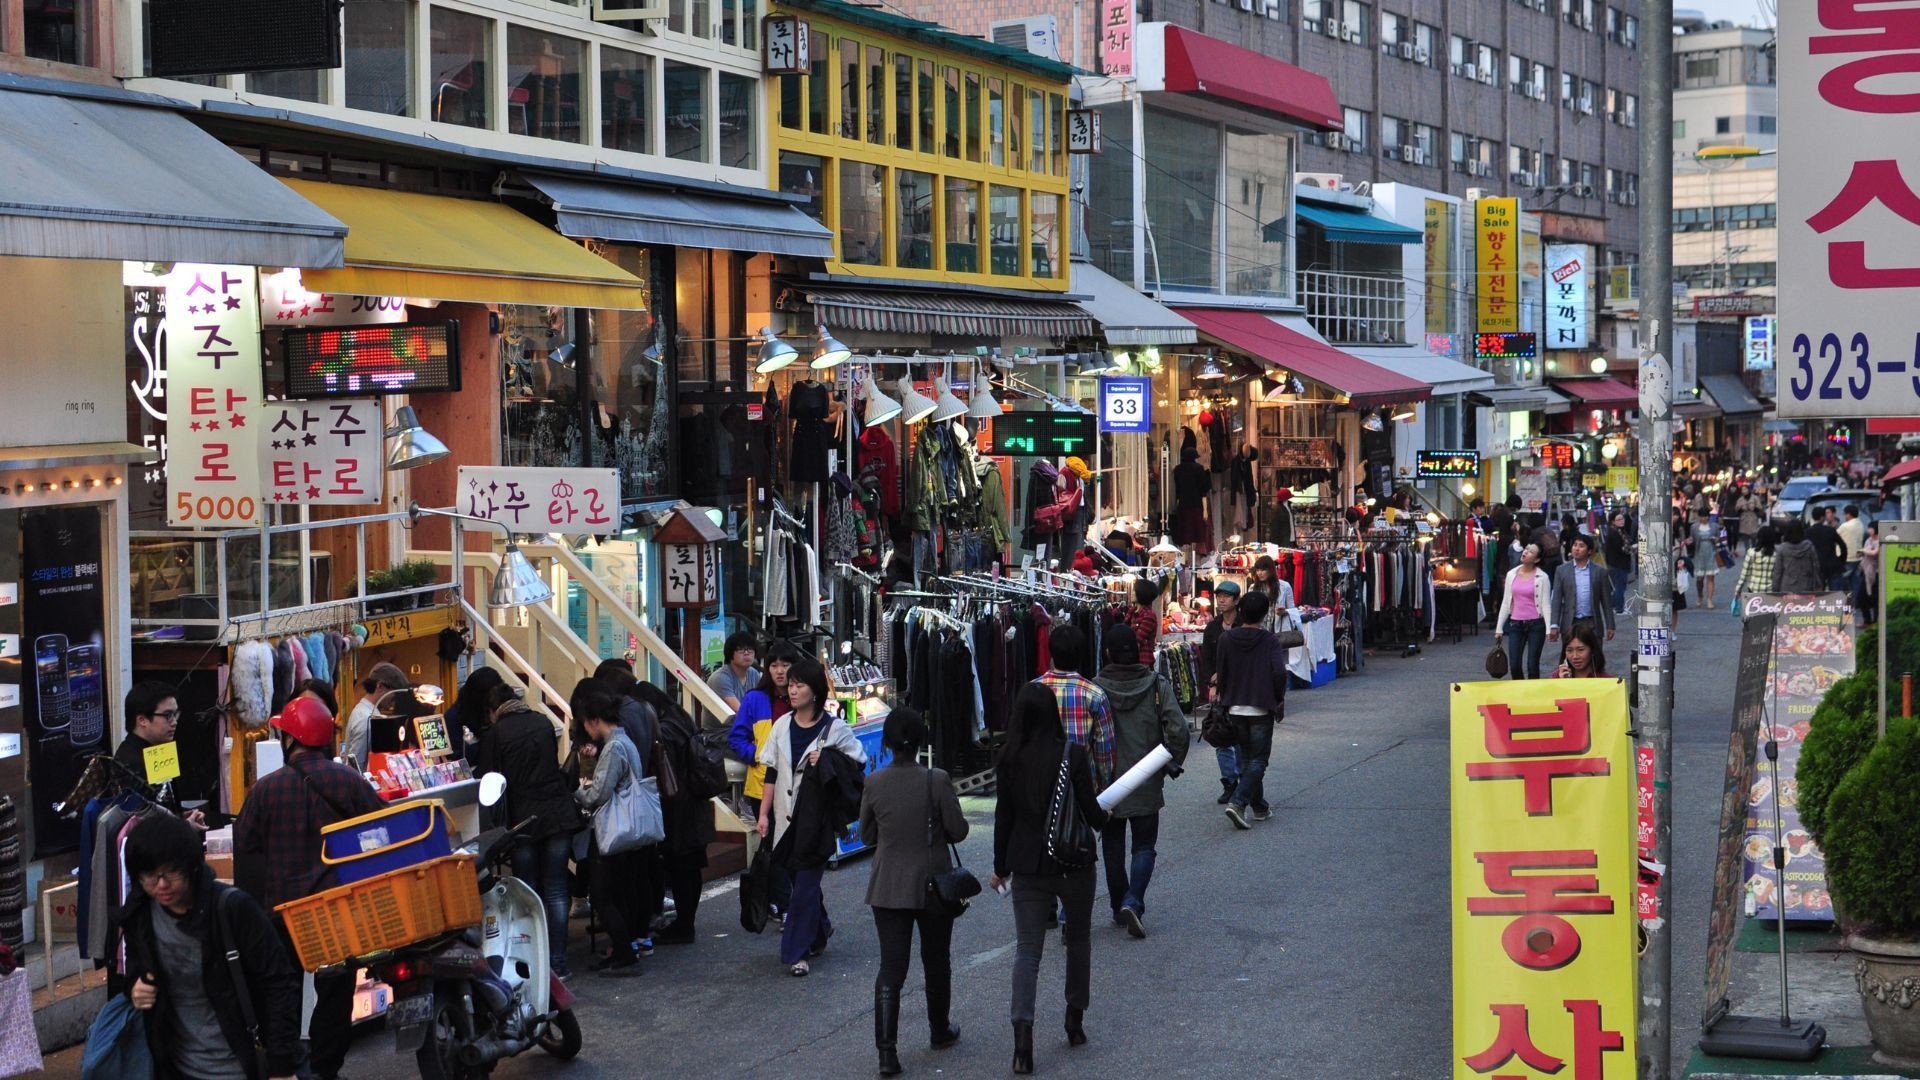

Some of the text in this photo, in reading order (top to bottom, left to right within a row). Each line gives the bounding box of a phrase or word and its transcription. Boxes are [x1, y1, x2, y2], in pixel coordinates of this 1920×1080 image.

[771, 21, 793, 69] 포차
[1071, 113, 1088, 145] 홍대
[1487, 206, 1506, 216] Big
[1483, 219, 1509, 227] Sale
[65, 400, 95, 412] ring ring
[1113, 398, 1137, 415] 33
[177, 491, 255, 521] 5000
[1462, 698, 1625, 1080] 부동산
